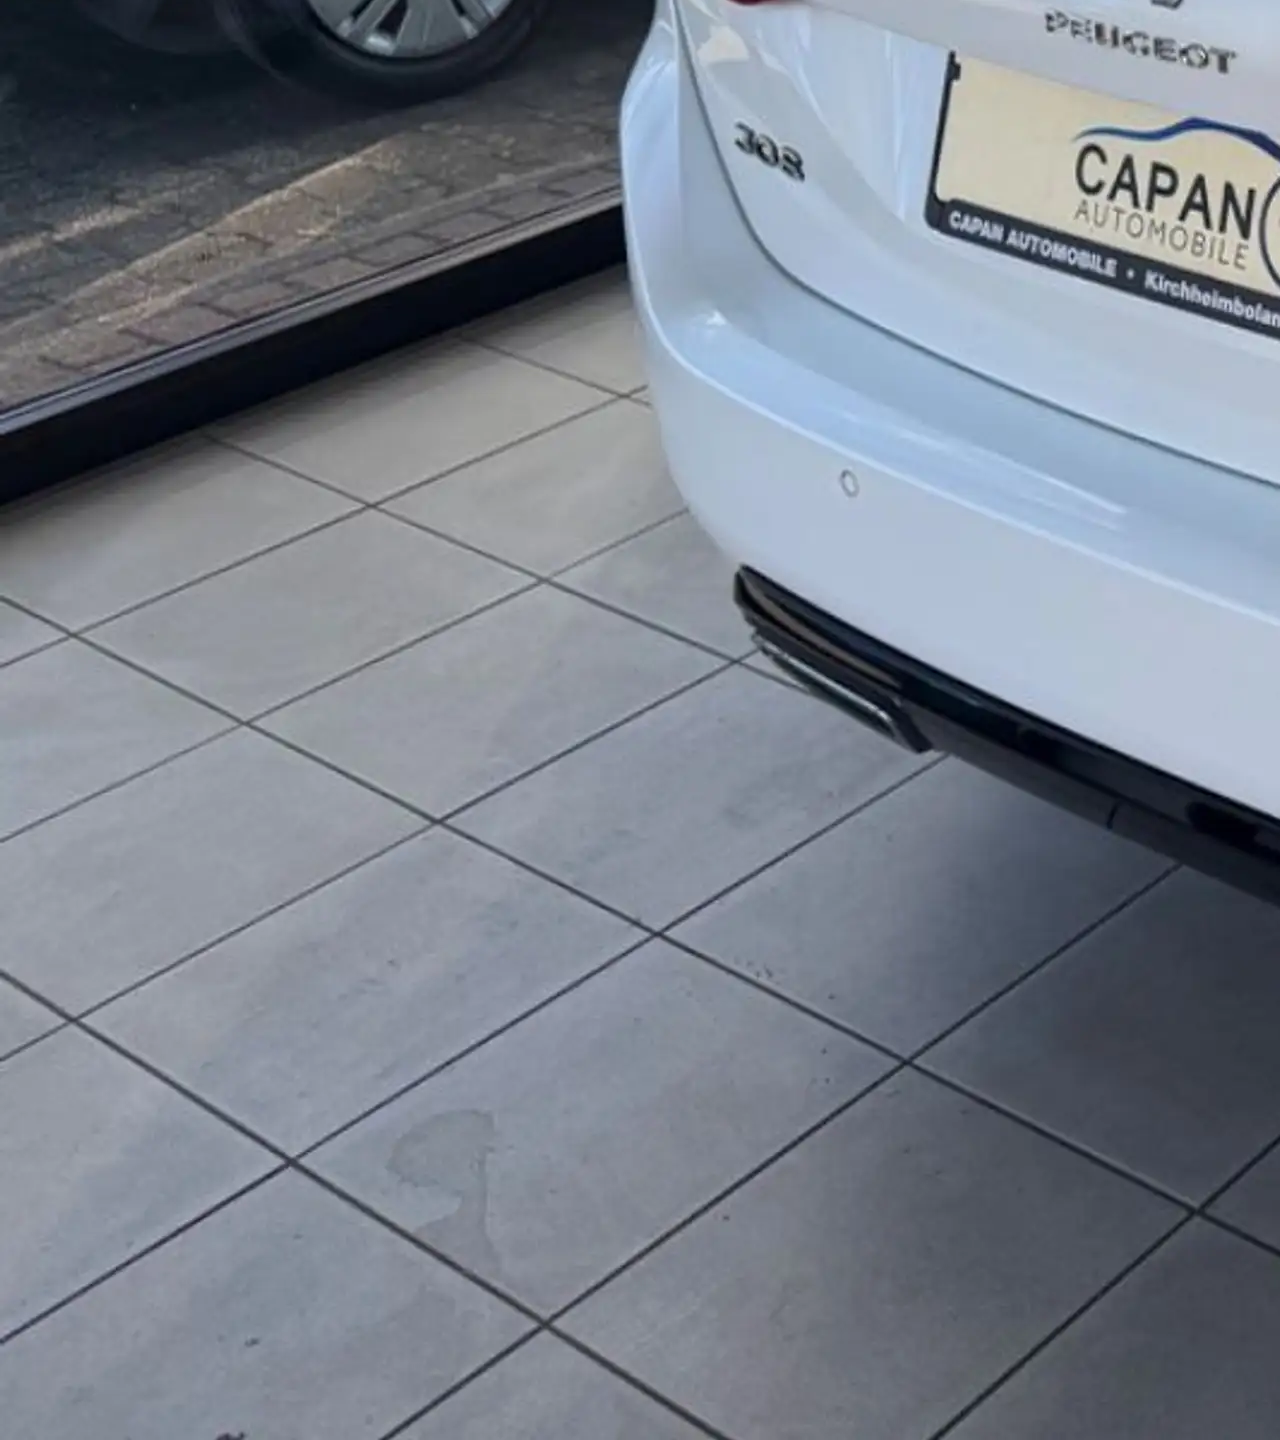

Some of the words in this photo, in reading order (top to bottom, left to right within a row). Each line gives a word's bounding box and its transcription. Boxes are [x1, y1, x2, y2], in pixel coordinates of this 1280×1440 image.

[1045, 9, 1237, 74] PEUGEOT
[734, 121, 805, 182] 308
[1075, 142, 1257, 241] CAPAN
[949, 210, 1004, 242] CAPAN
[1006, 229, 1118, 278] AUTOMOBILE
[1074, 199, 1250, 271] AUTOMOBILE
